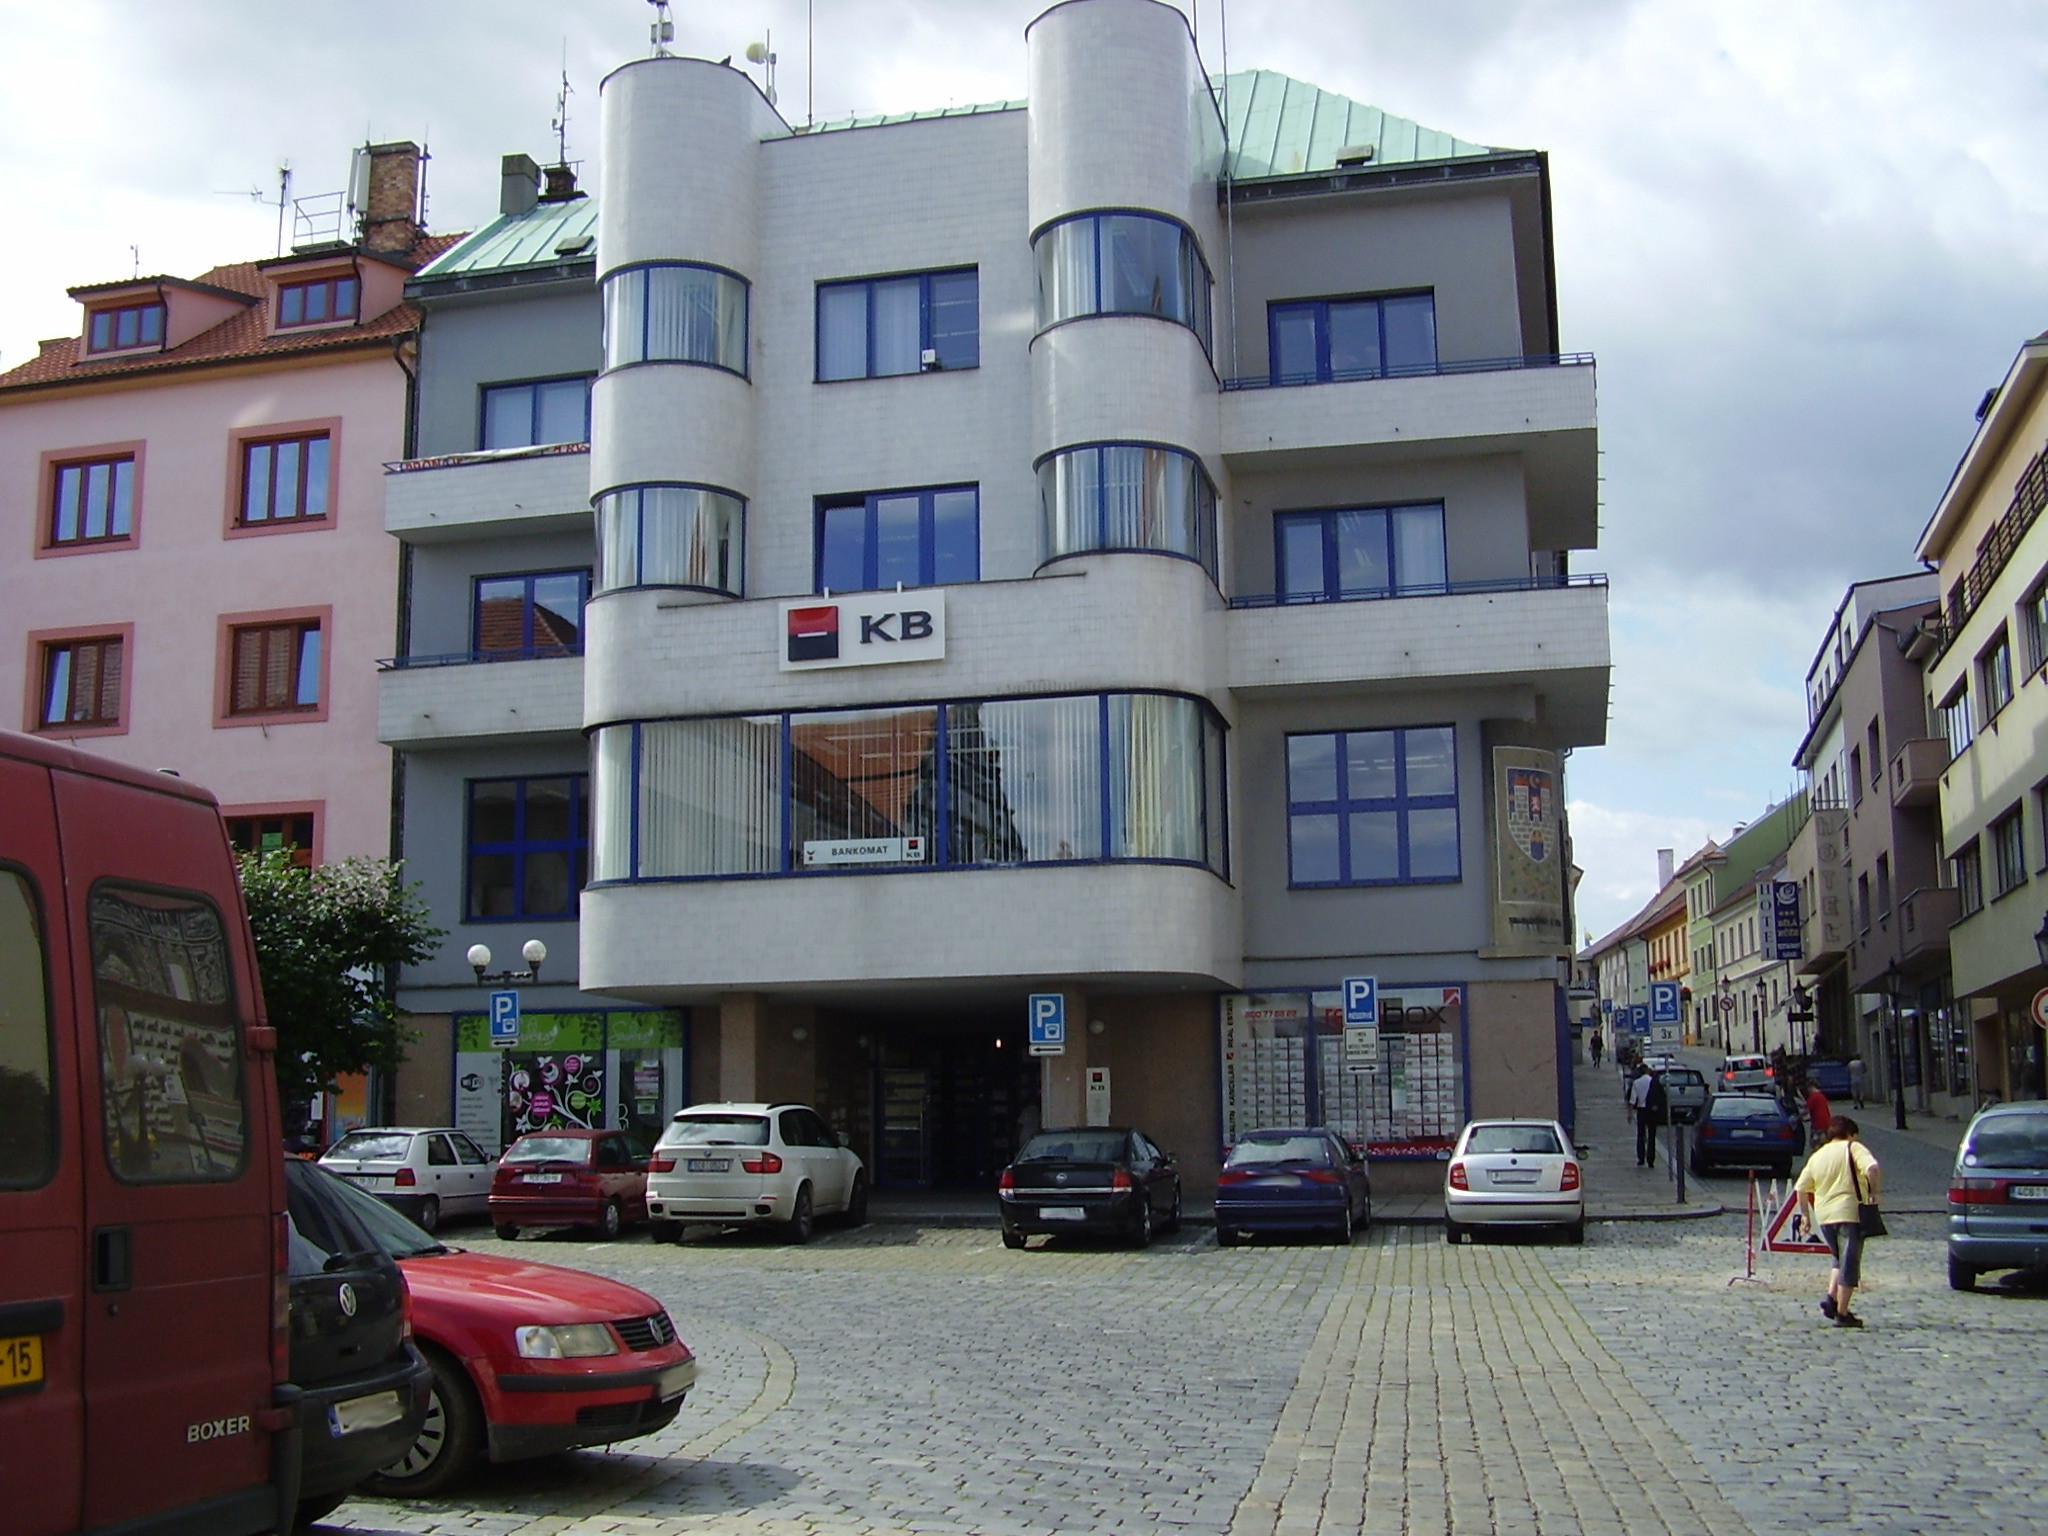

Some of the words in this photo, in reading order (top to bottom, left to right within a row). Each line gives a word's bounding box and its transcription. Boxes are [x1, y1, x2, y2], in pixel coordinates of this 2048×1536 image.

[859, 611, 934, 644] KB
[831, 846, 889, 856] BANKOMAT
[1352, 981, 1369, 1009] P
[1655, 987, 1673, 1011] P
[1036, 1000, 1056, 1028] P
[187, 1415, 250, 1443] BOXER
